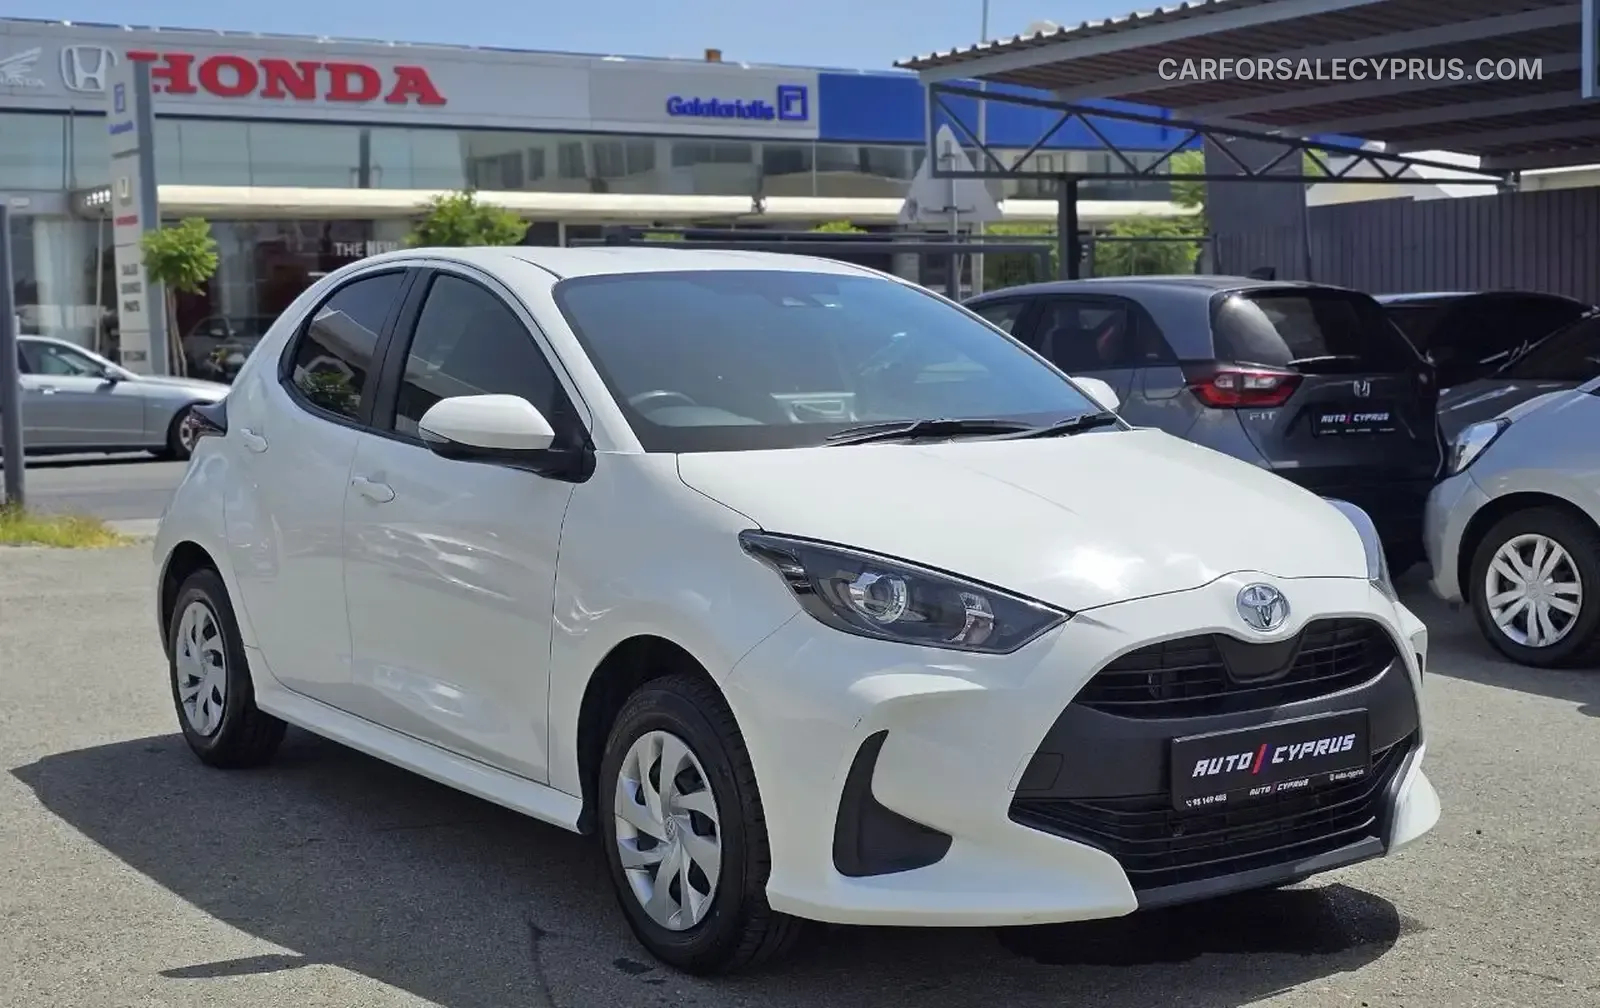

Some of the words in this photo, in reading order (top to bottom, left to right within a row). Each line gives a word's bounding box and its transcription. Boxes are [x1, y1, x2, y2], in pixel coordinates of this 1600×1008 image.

[127, 51, 447, 106] HONDA
[334, 242, 364, 257] THE
[1249, 411, 1277, 421] FIT
[1321, 414, 1346, 423] AUTO
[1353, 412, 1389, 422] CYPRUS
[1192, 752, 1253, 777] AUTO
[1271, 734, 1356, 764] CYPRUS
[1249, 786, 1272, 796] AUTO
[1277, 779, 1309, 791] CYPRUS
